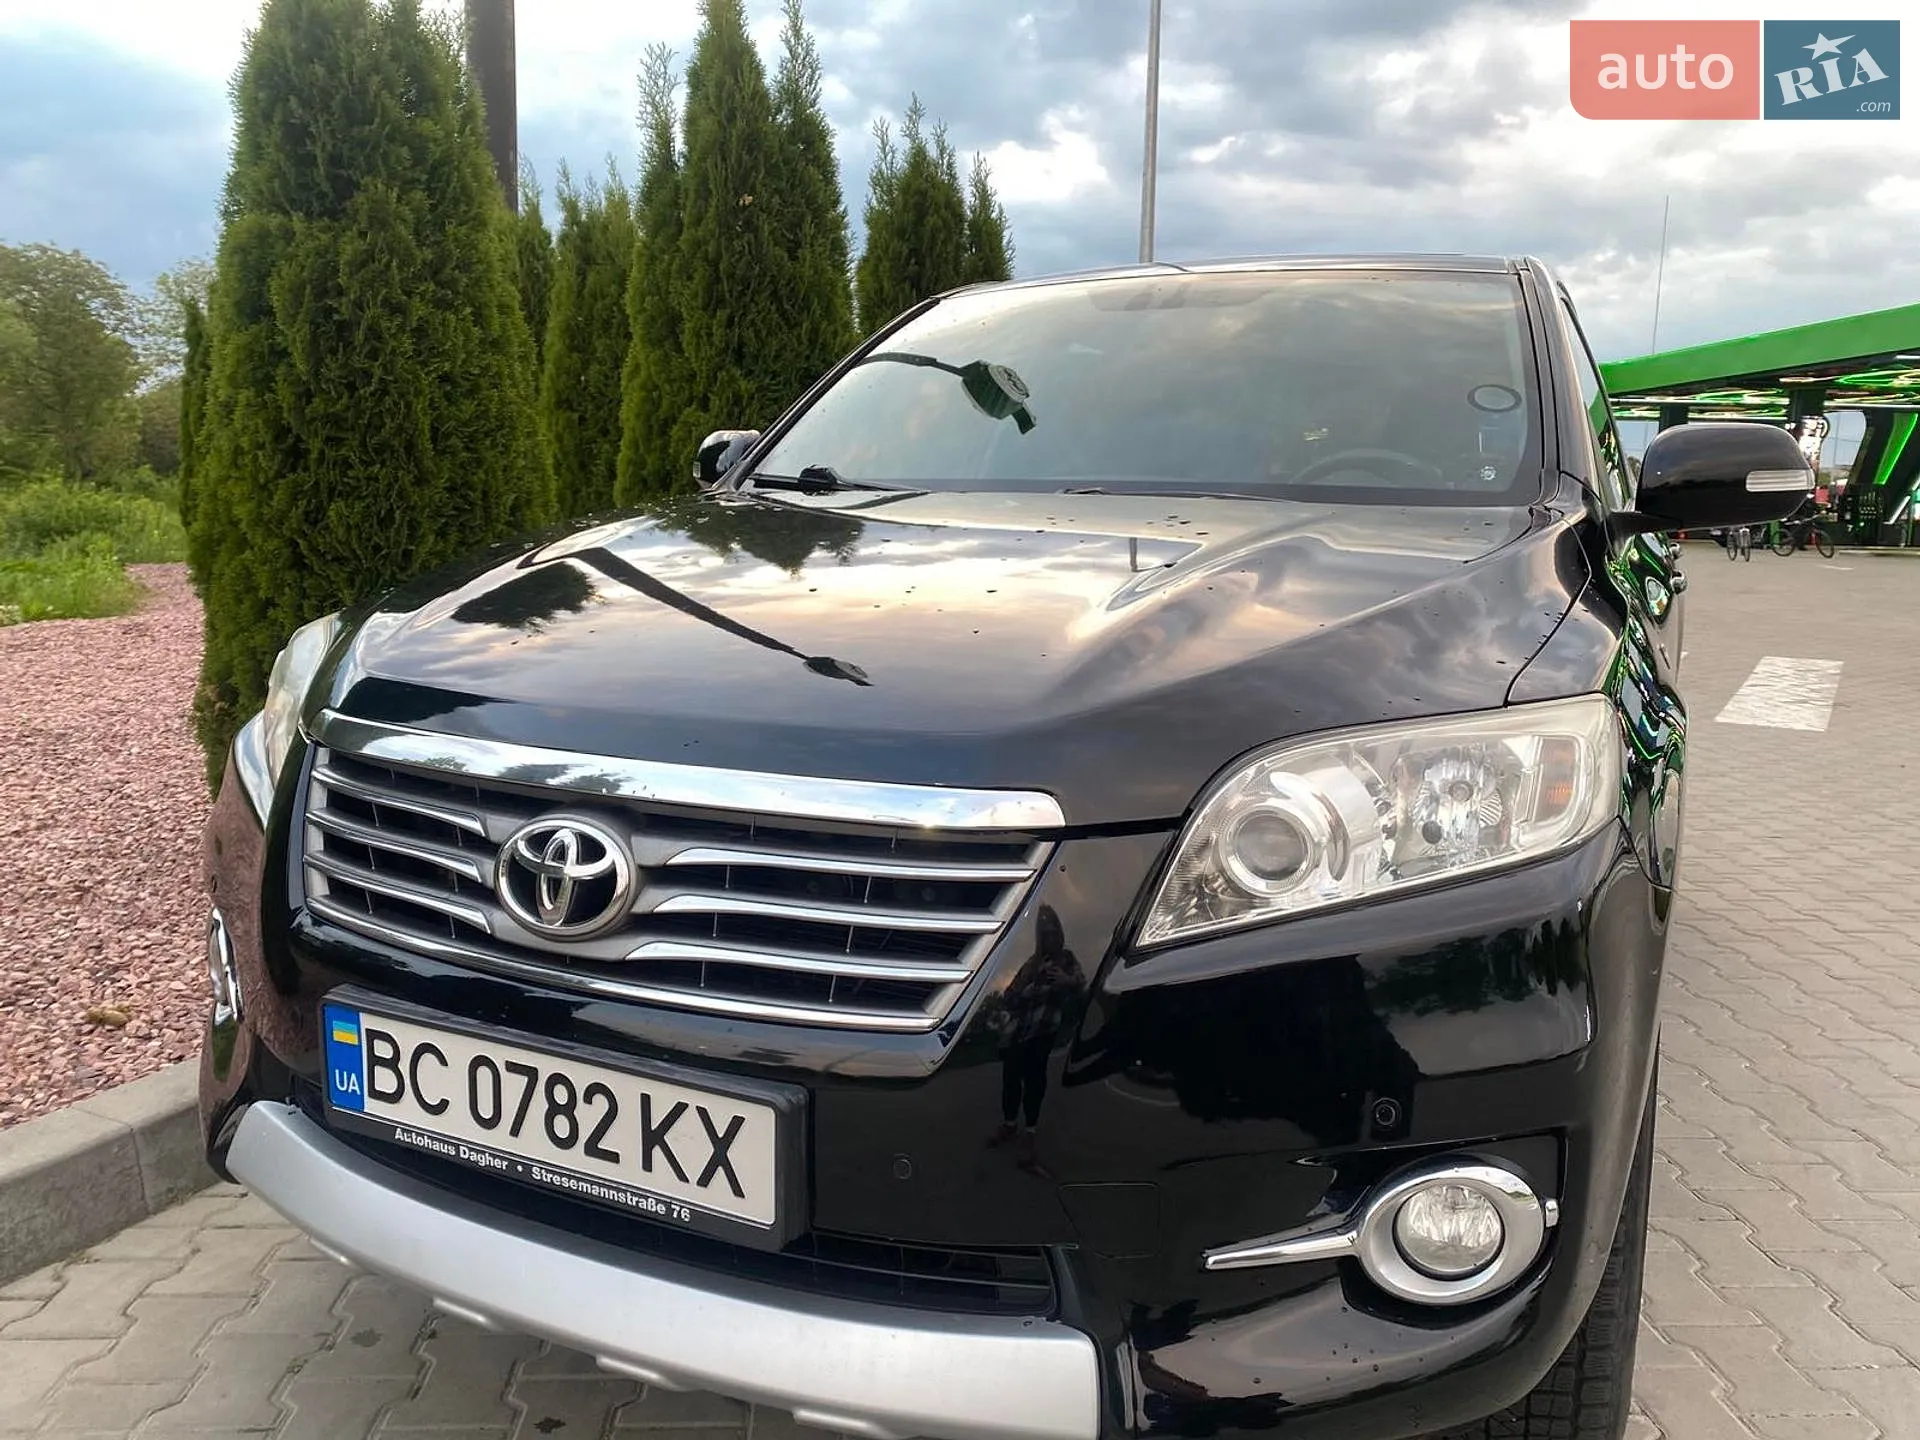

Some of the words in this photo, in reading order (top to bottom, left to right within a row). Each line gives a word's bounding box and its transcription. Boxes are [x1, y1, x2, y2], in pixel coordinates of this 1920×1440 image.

[335, 1069, 361, 1095] UA
[366, 1027, 450, 1115] BC
[468, 1054, 620, 1164] 0782
[641, 1092, 746, 1199] KX
[394, 1127, 456, 1156] Autohaus
[459, 1144, 508, 1172] Dagher
[531, 1166, 666, 1215] Stresemannstraße
[671, 1204, 691, 1222] 76
